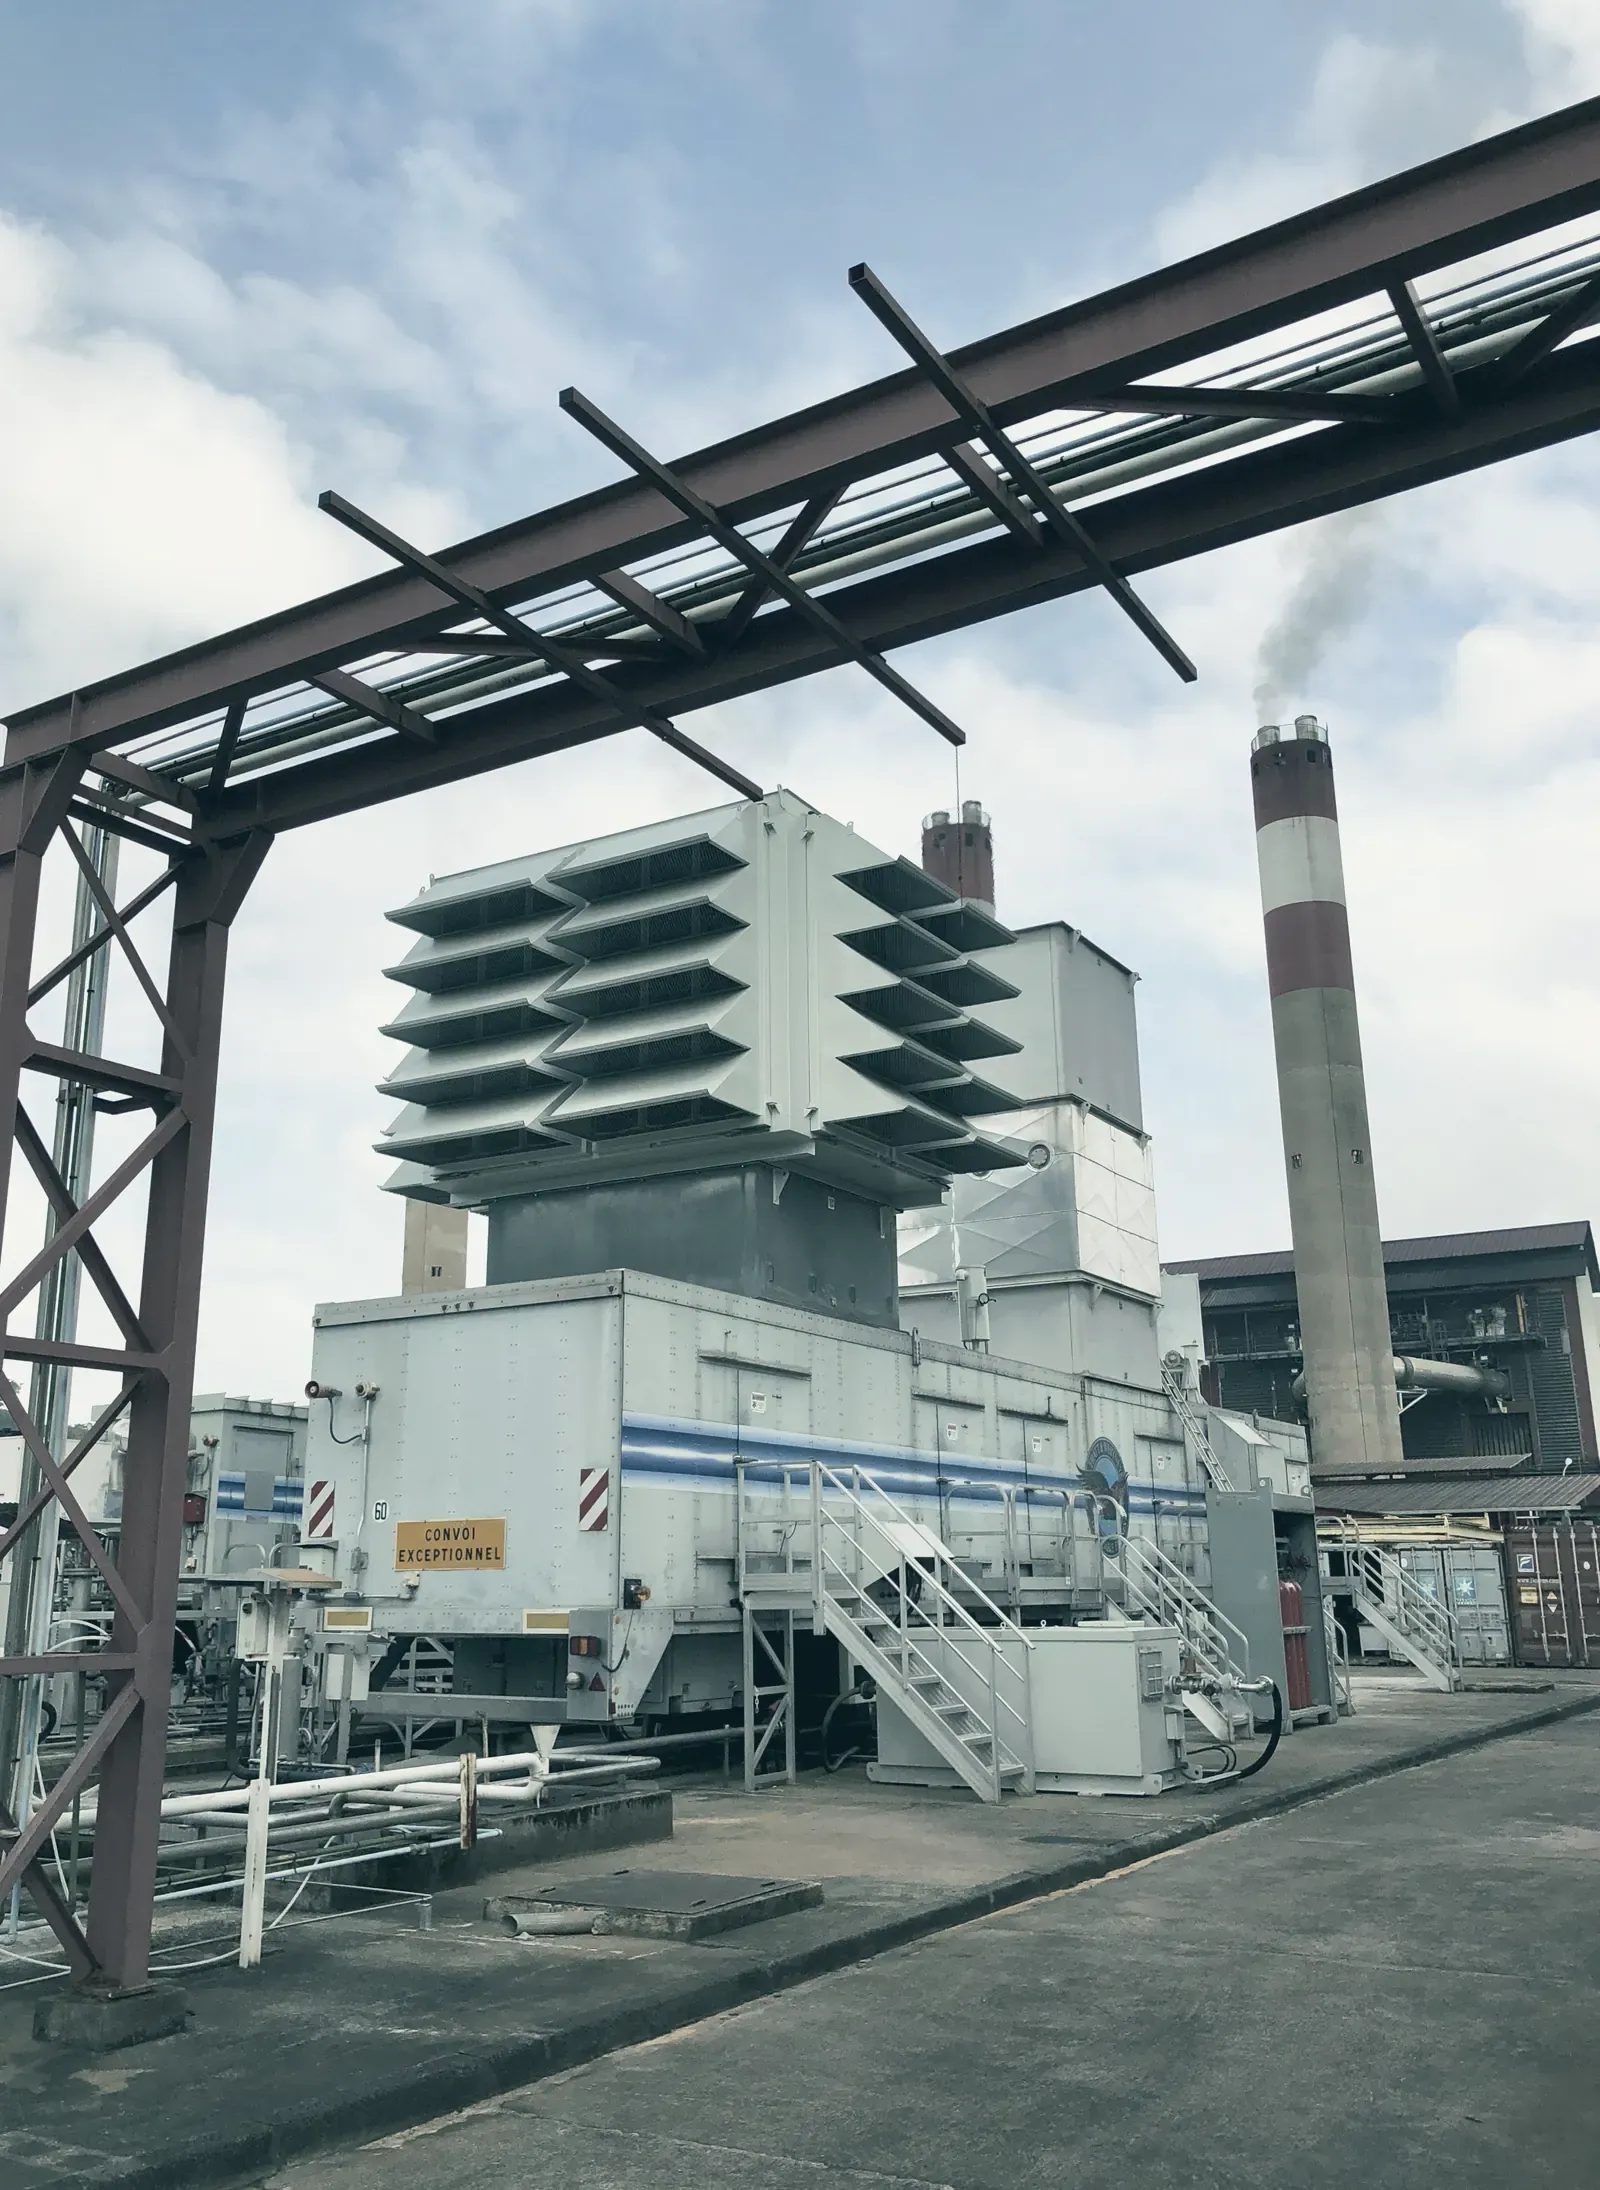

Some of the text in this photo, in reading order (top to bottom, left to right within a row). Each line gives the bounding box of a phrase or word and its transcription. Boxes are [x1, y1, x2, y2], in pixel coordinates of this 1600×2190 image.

[374, 1501, 388, 1520] 60
[425, 1527, 476, 1541] CONVOI
[398, 1546, 501, 1562] EXCEPTIONNEL
